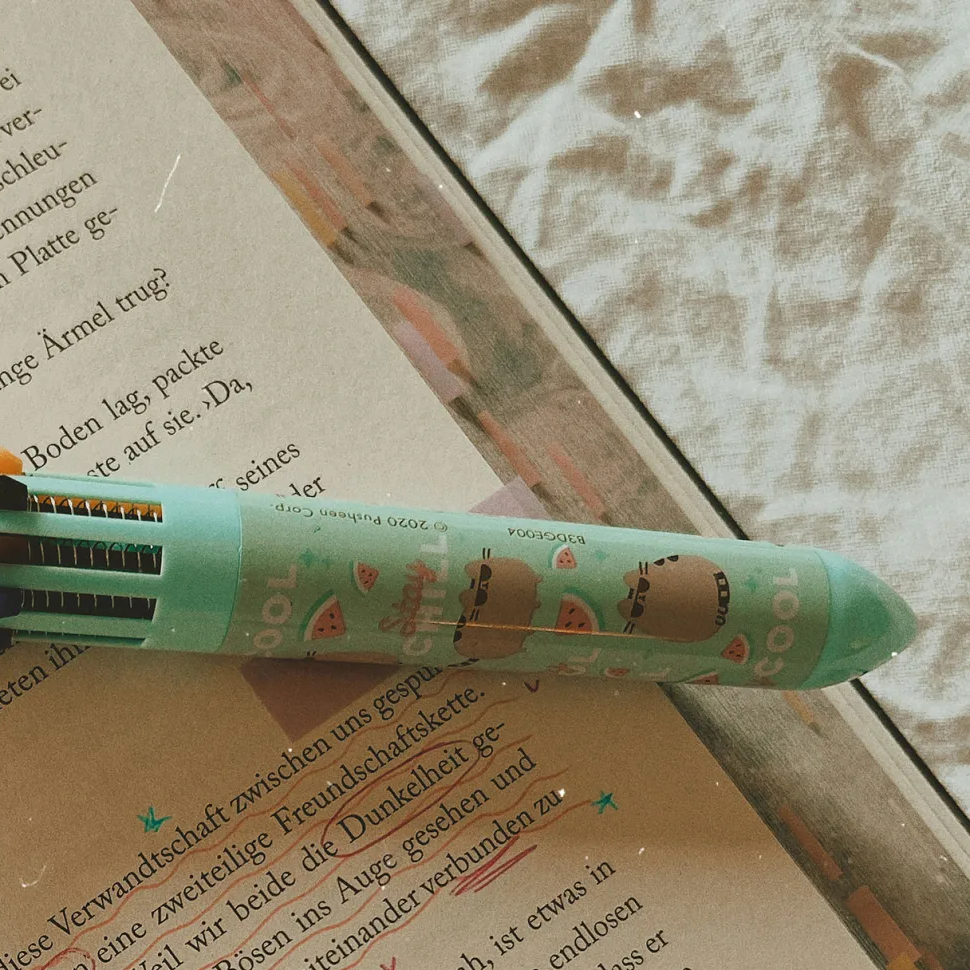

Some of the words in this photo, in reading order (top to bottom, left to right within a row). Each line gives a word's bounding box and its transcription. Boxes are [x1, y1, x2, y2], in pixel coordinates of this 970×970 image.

[6, 229, 80, 277] Platte
[84, 208, 118, 241] ge-
[36, 300, 116, 360] Ärmel
[114, 267, 170, 313] trug?
[20, 417, 104, 472] Boden
[101, 390, 152, 421] lag,
[151, 340, 224, 400] packte
[123, 420, 162, 462] auf
[162, 409, 202, 436] sie.
[235, 443, 300, 492] seines
[269, 502, 314, 519] Corp.
[318, 508, 381, 526] Pusheen
[386, 515, 429, 531] 2020
[753, 567, 799, 677] COOL
[46, 802, 231, 936] Verwandtschaft
[229, 738, 334, 815] zwischen
[329, 708, 373, 742] uns
[96, 922, 148, 964] eine
[150, 832, 274, 926] zweiteilige
[270, 688, 486, 836] Freundschaftskette.
[418, 810, 536, 896] verbunden
[532, 790, 564, 817] zu
[548, 896, 644, 970] endlosen
